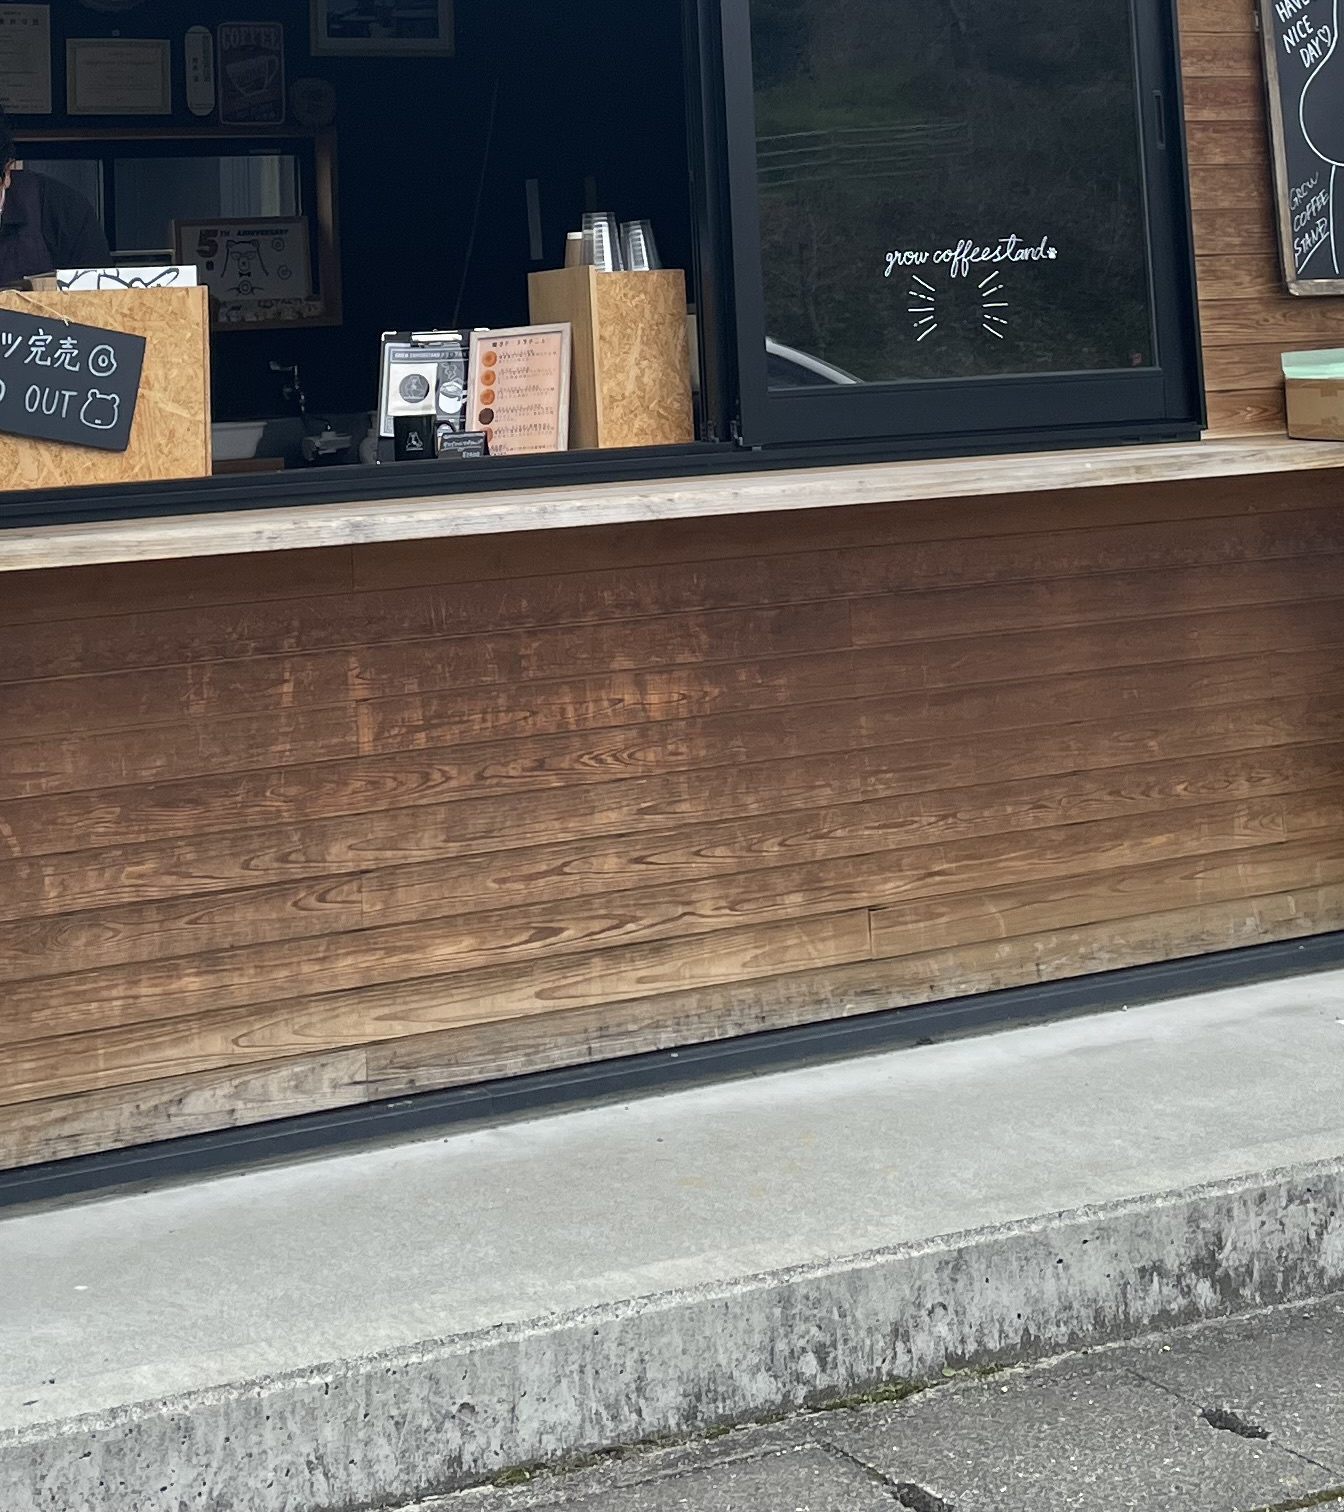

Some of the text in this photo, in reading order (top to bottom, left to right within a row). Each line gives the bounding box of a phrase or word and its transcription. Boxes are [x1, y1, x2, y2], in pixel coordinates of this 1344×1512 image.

[1282, 14, 1314, 54] NICE
[1299, 36, 1323, 68] DAY
[1294, 189, 1329, 232] COFFEE
[1294, 217, 1328, 262] STAND
[884, 249, 929, 277] grow
[25, 385, 78, 418] OUT
